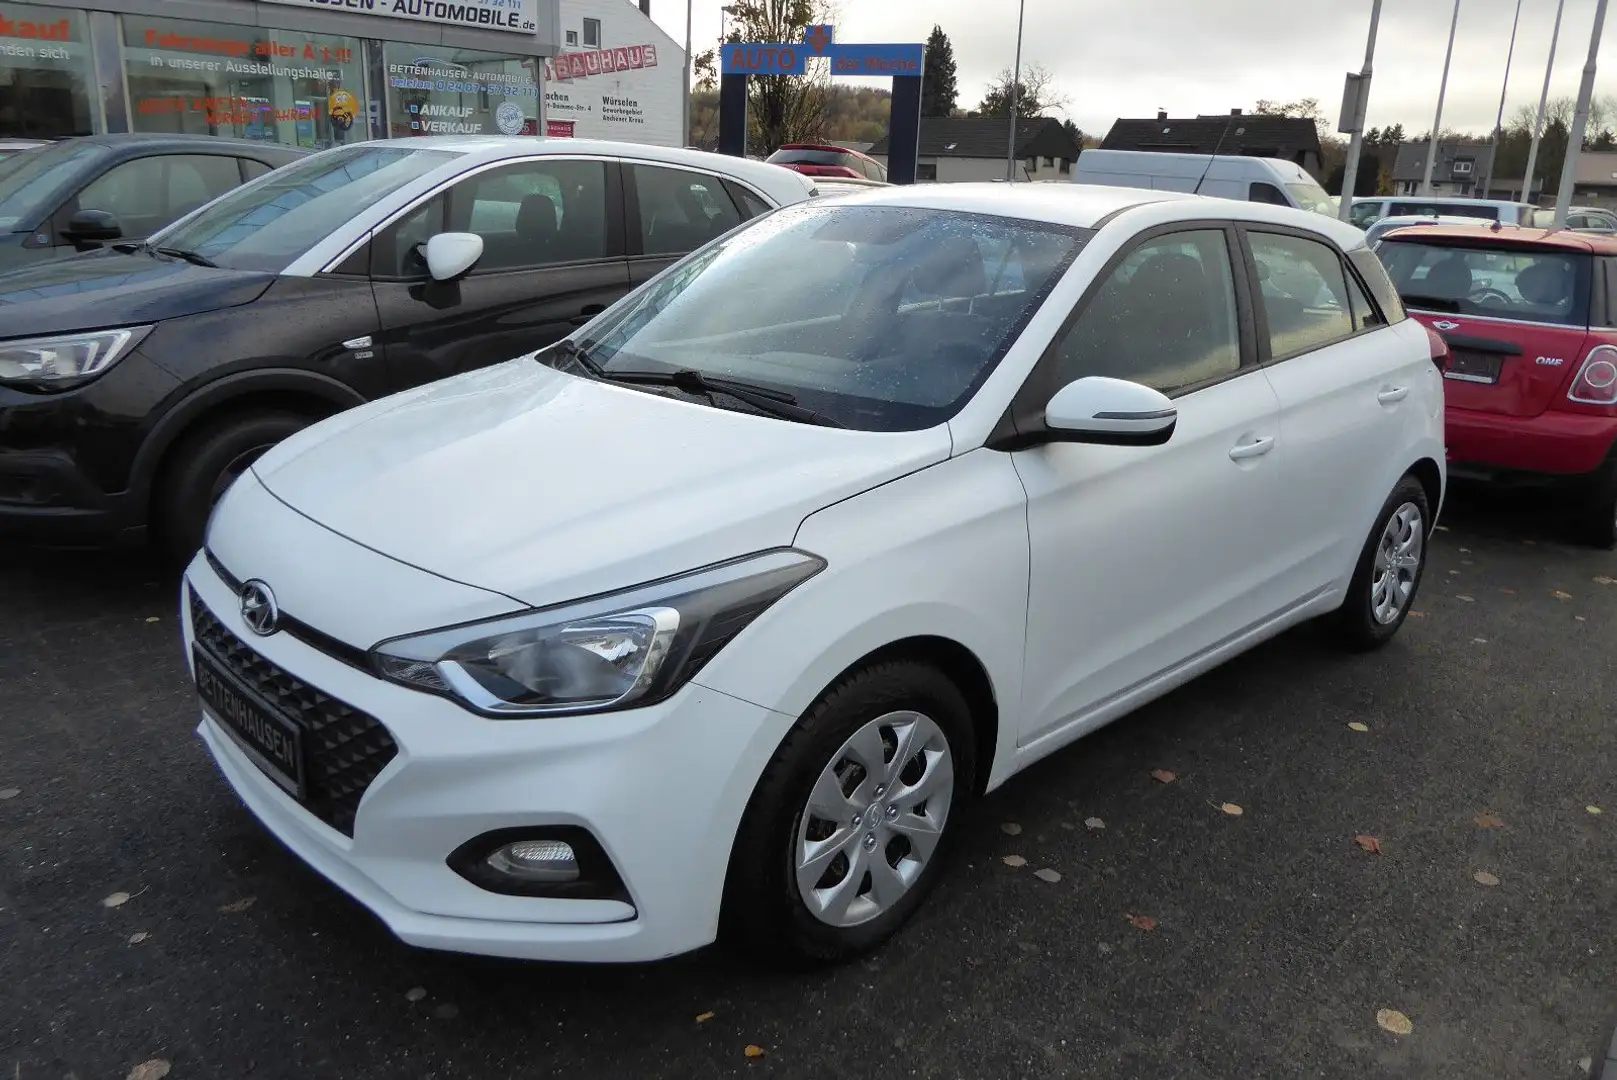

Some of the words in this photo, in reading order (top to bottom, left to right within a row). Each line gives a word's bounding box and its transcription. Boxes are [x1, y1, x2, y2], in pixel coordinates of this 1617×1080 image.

[39, 47, 70, 60] sich
[730, 48, 796, 70] AUTO
[149, 55, 163, 67] in
[168, 57, 221, 71] unserer
[556, 46, 656, 79] BAUHAUS
[835, 57, 861, 71] der
[602, 96, 638, 107] Würselen
[420, 104, 474, 118] ANKAUF
[421, 120, 482, 135] VERKAUF
[1535, 356, 1564, 366] ONE
